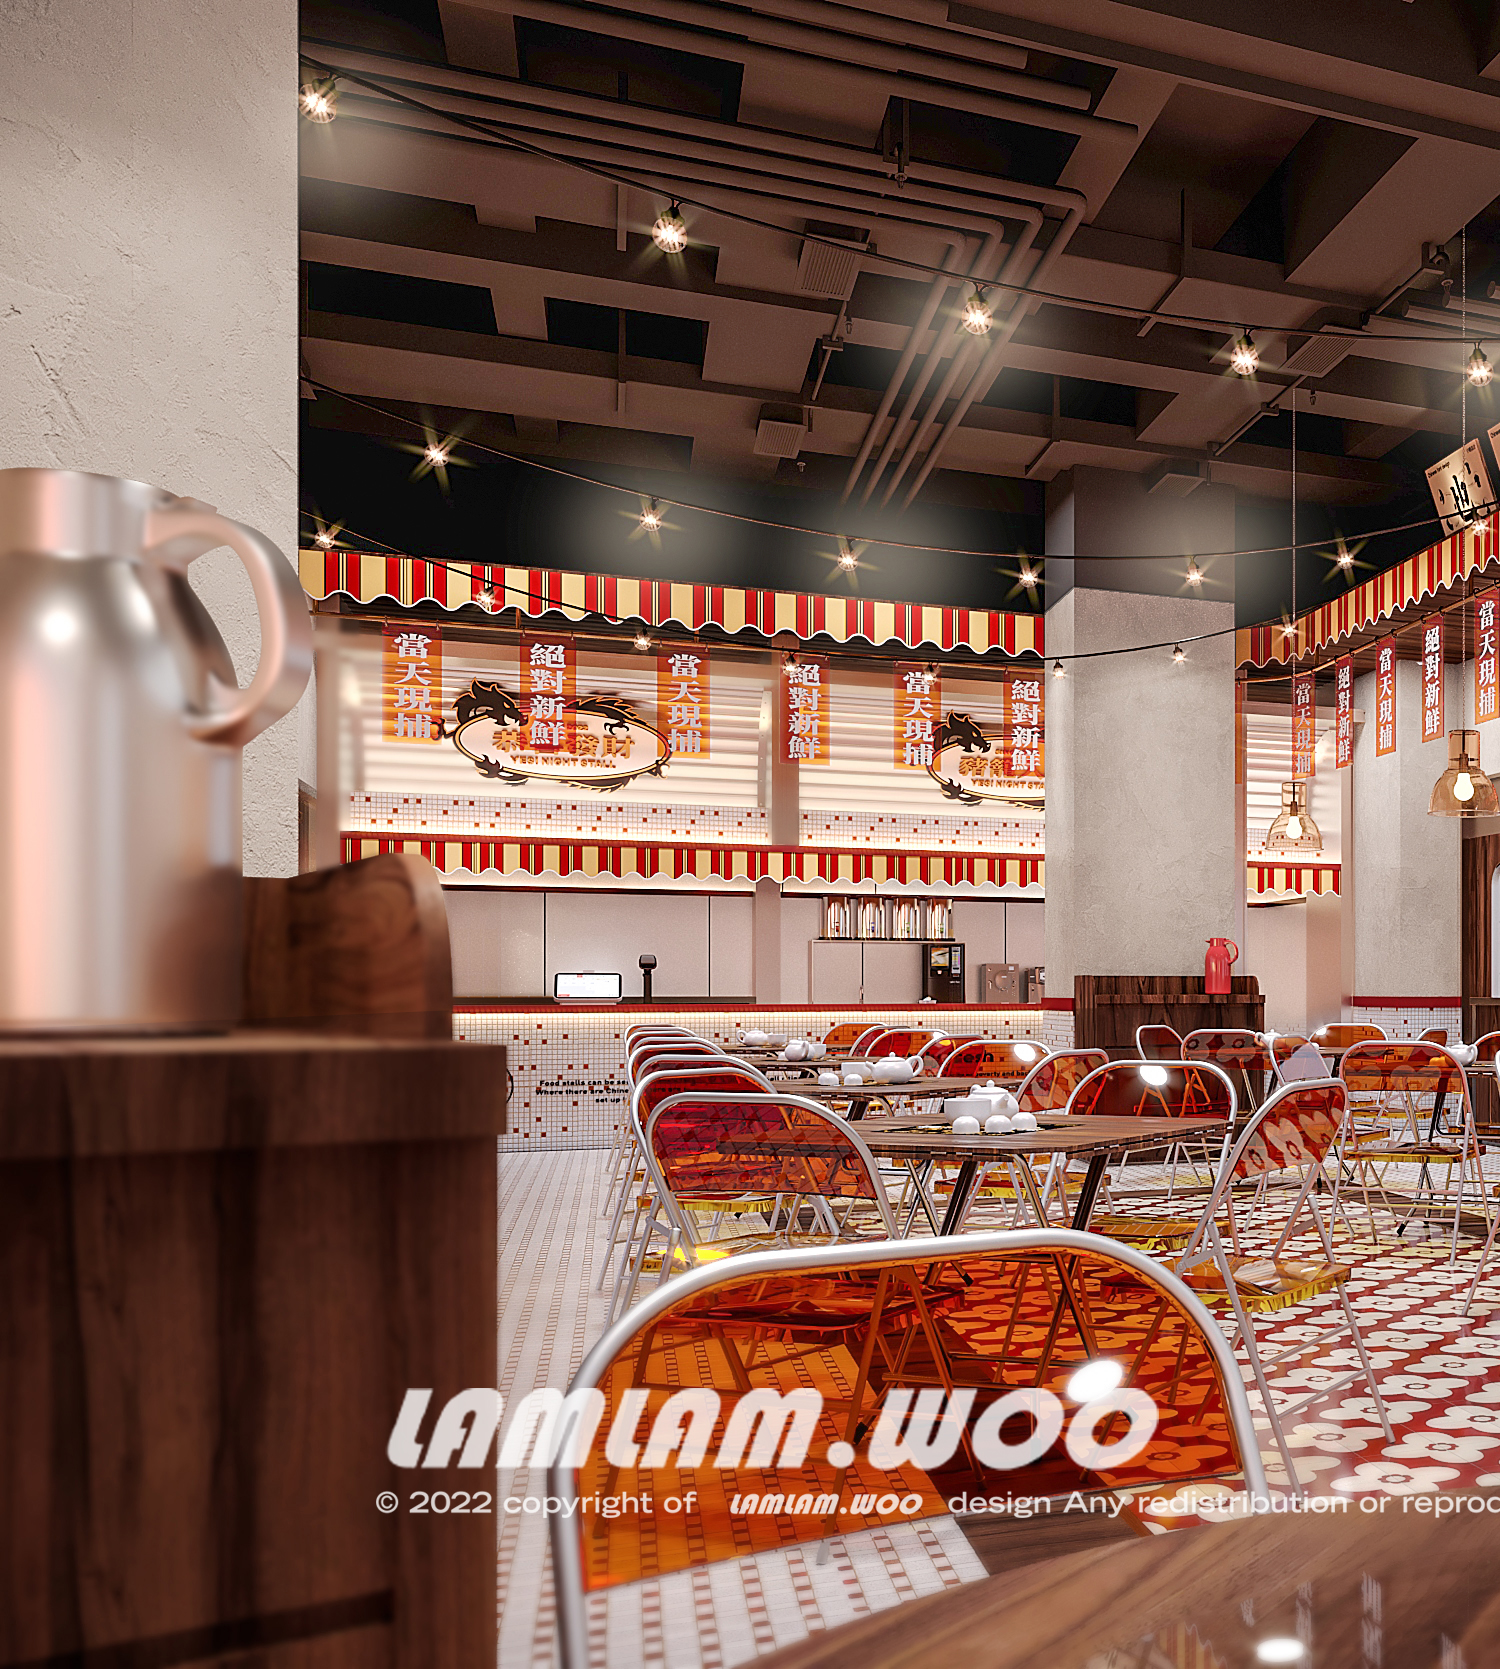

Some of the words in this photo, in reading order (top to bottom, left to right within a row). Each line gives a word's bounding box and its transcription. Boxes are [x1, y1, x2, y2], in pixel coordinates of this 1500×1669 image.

[394, 632, 433, 740] 當天現捕
[529, 642, 567, 747] 絕對新鮮
[667, 653, 703, 753] 當天現捕
[1378, 647, 1393, 750] 當天現捕
[1424, 625, 1441, 736] 絕對新鮮
[1478, 600, 1496, 717] 當天現捕
[492, 729, 636, 759] 恭發財
[788, 663, 822, 759] 絕對新鮮
[902, 671, 935, 766] 當天現捕
[1011, 679, 1042, 772] 絕對新鮮
[1295, 682, 1312, 773] 當天現捕
[1337, 665, 1351, 763] 絕對新鮮
[510, 755, 539, 765] YES!
[541, 756, 578, 767] NIGHT
[580, 758, 617, 769] STALL
[971, 778, 994, 788] YES!
[995, 779, 1027, 789] NIGHT
[1027, 781, 1046, 790] STA
[535, 1088, 563, 1096] Where
[605, 1087, 629, 1095] Chine
[540, 1079, 559, 1087] Food
